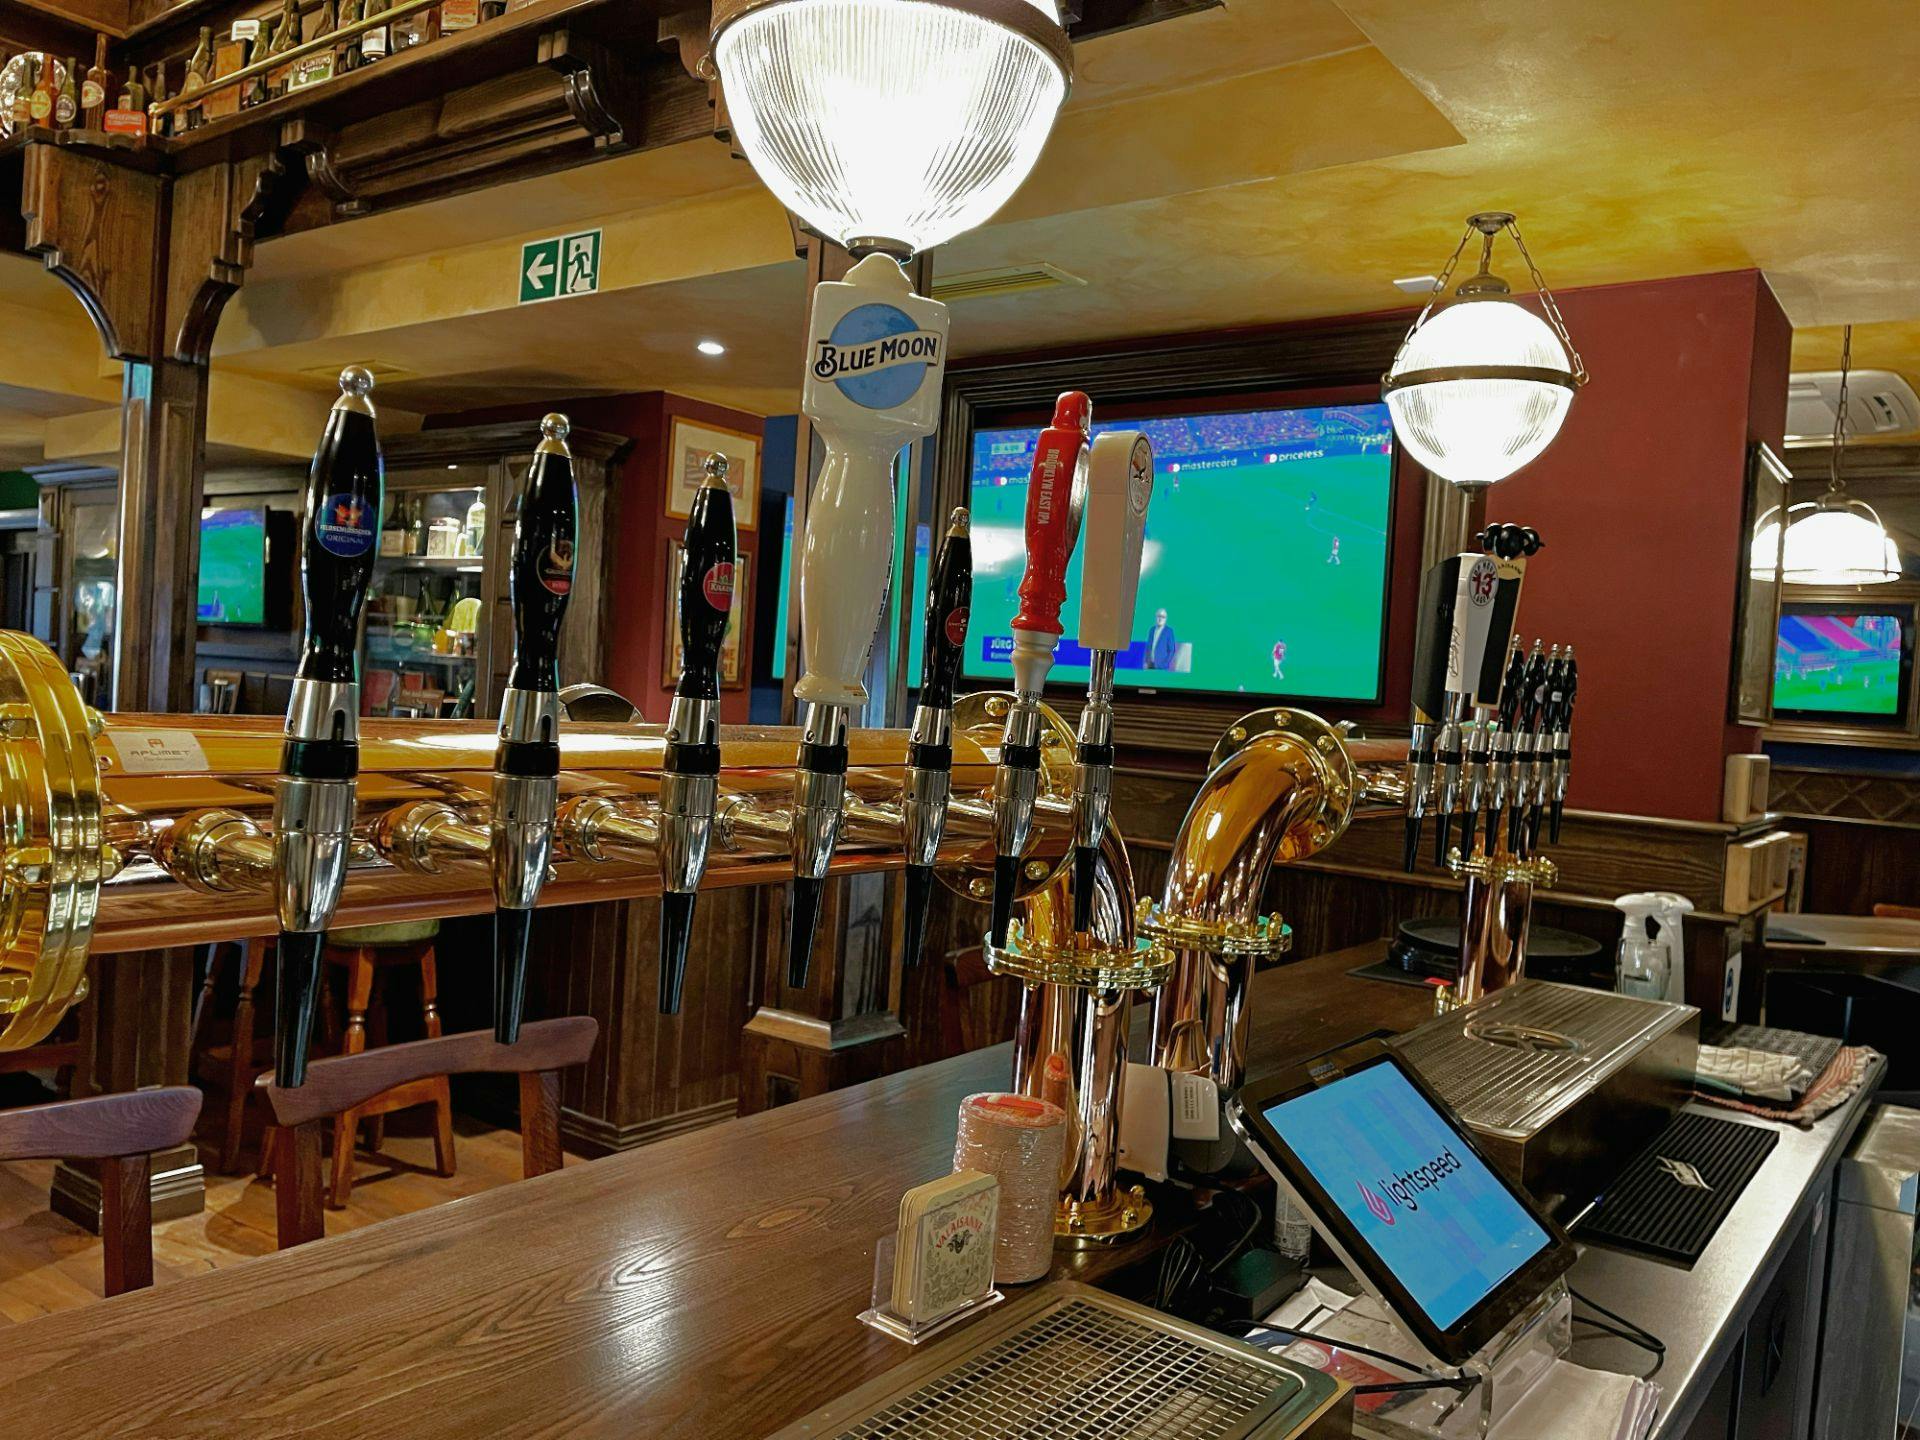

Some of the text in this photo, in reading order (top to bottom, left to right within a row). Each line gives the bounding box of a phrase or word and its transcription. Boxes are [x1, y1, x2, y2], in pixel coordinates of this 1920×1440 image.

[815, 337, 938, 378] BLUE MOON
[1181, 458, 1238, 472] mastercard
[1278, 449, 1324, 463] priceless
[1037, 448, 1060, 525] BROOKLYN EAST IPA
[325, 534, 365, 545] ORIGINAL
[1473, 572, 1494, 597] 13
[1377, 1144, 1462, 1212] lightspeed
[935, 1215, 985, 1249] VALAISANNE
